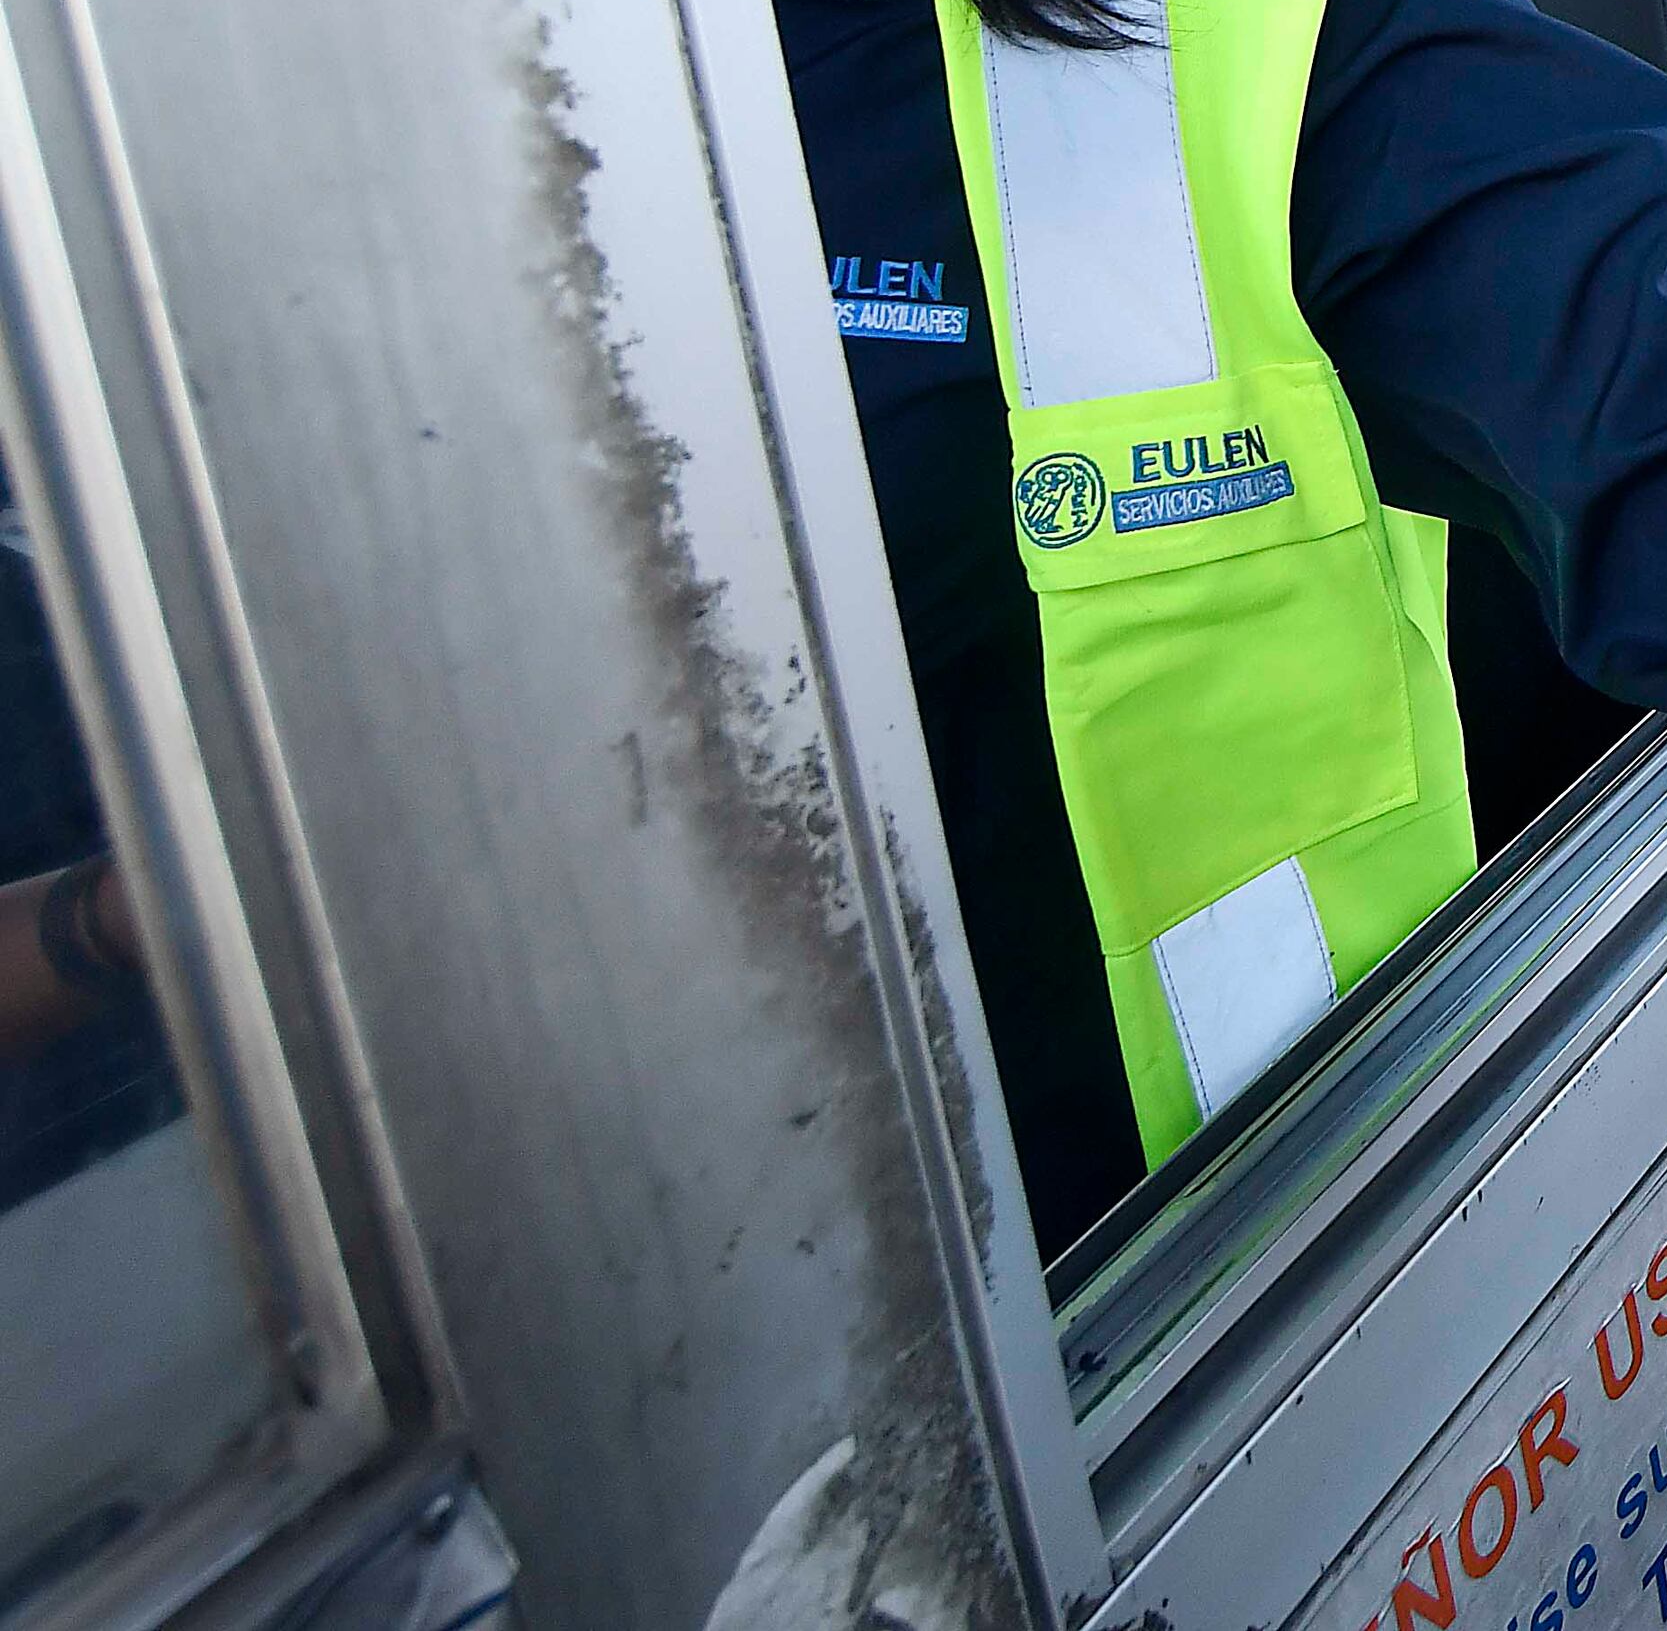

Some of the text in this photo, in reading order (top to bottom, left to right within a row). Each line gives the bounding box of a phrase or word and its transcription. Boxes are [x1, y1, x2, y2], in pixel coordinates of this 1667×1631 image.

[858, 302, 963, 335] AUXILIARES
[1131, 425, 1268, 483] EULEN
[1118, 488, 1216, 525] SERVICIOS
